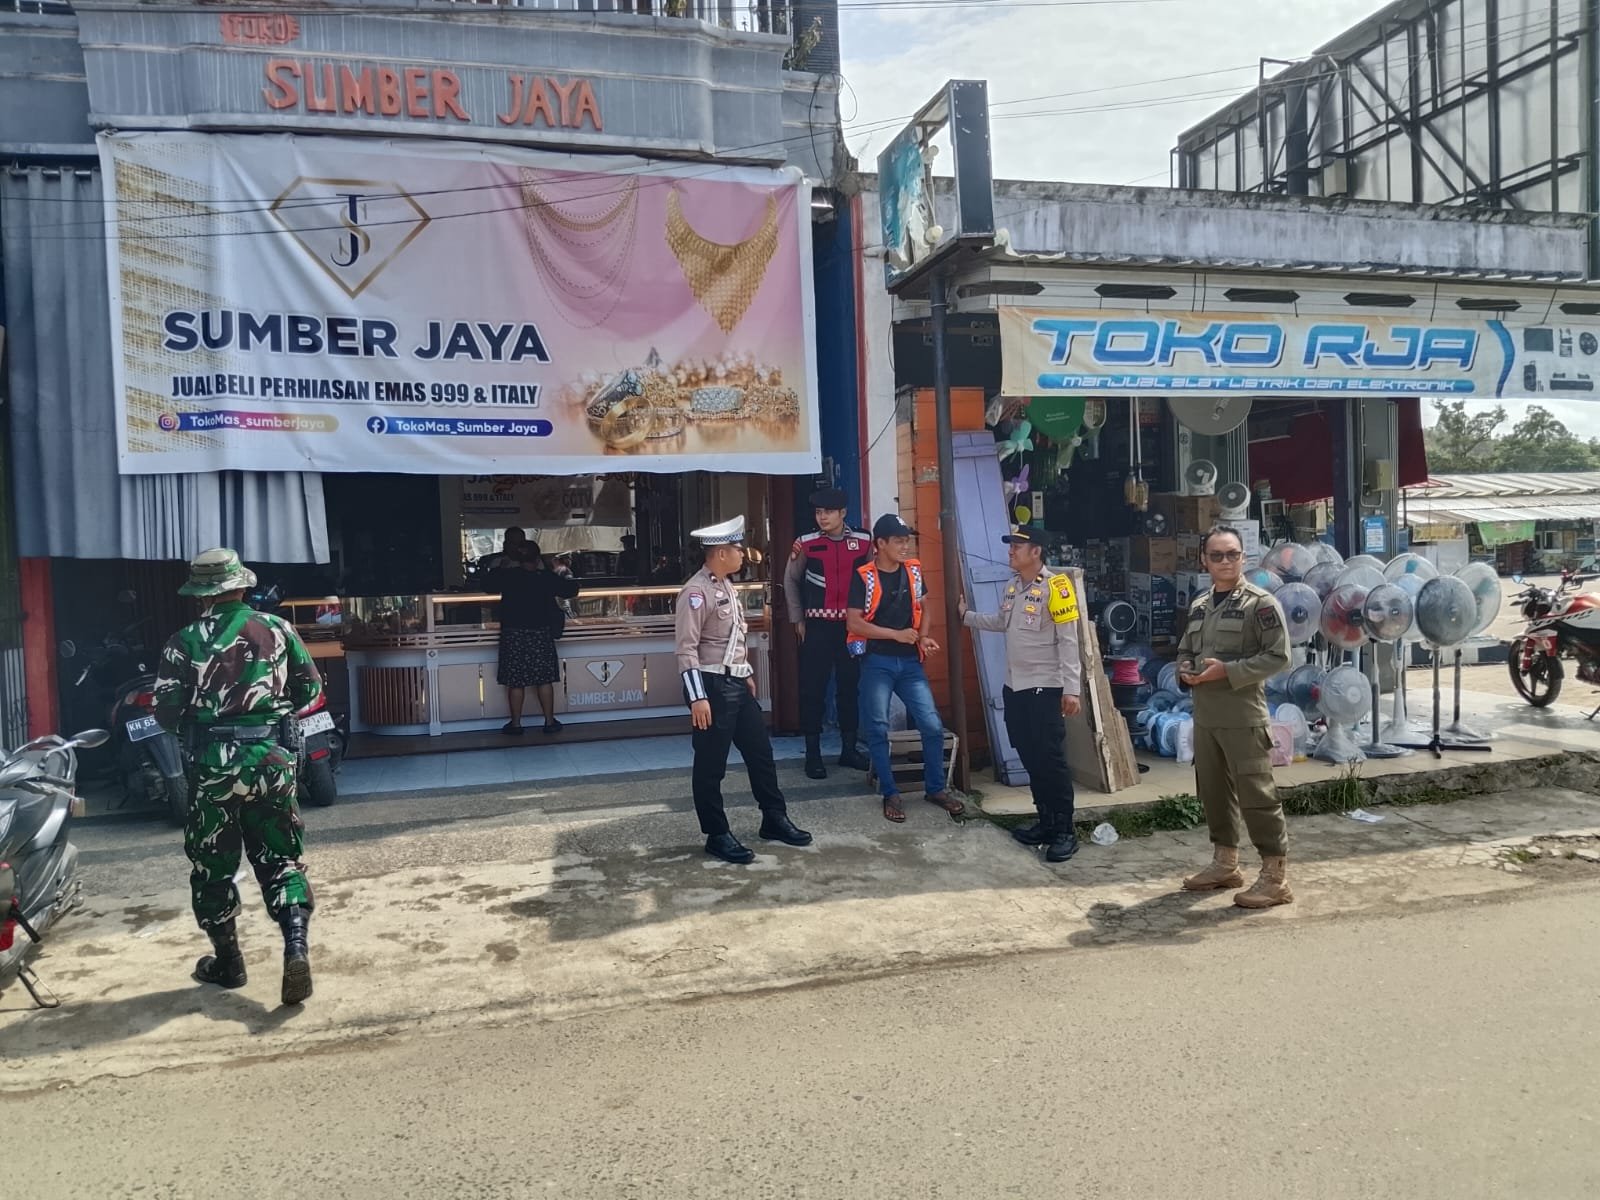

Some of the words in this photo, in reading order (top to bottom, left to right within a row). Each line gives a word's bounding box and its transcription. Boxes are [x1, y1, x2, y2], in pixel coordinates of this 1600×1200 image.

[263, 58, 471, 122] SUMBER
[497, 75, 603, 131] JAYA
[164, 309, 399, 359] SUMBER
[414, 320, 551, 364] JAYA
[1032, 319, 1284, 365] TOKO
[1302, 324, 1479, 370] RJA
[171, 376, 213, 397] JUAL
[215, 374, 255, 396] BELI
[260, 378, 369, 400] PERHIASAN
[374, 381, 426, 402] EMAS
[430, 383, 469, 403] 999
[474, 387, 487, 403] &
[491, 386, 539, 405] ITALY
[190, 414, 326, 430] TokoMas_sumberjaya
[396, 420, 505, 435] TokoMas_Sumber
[508, 422, 538, 435] Jaya
[569, 691, 615, 706] SUMBER
[618, 688, 643, 703] JAYA
[129, 721, 142, 732] KH
